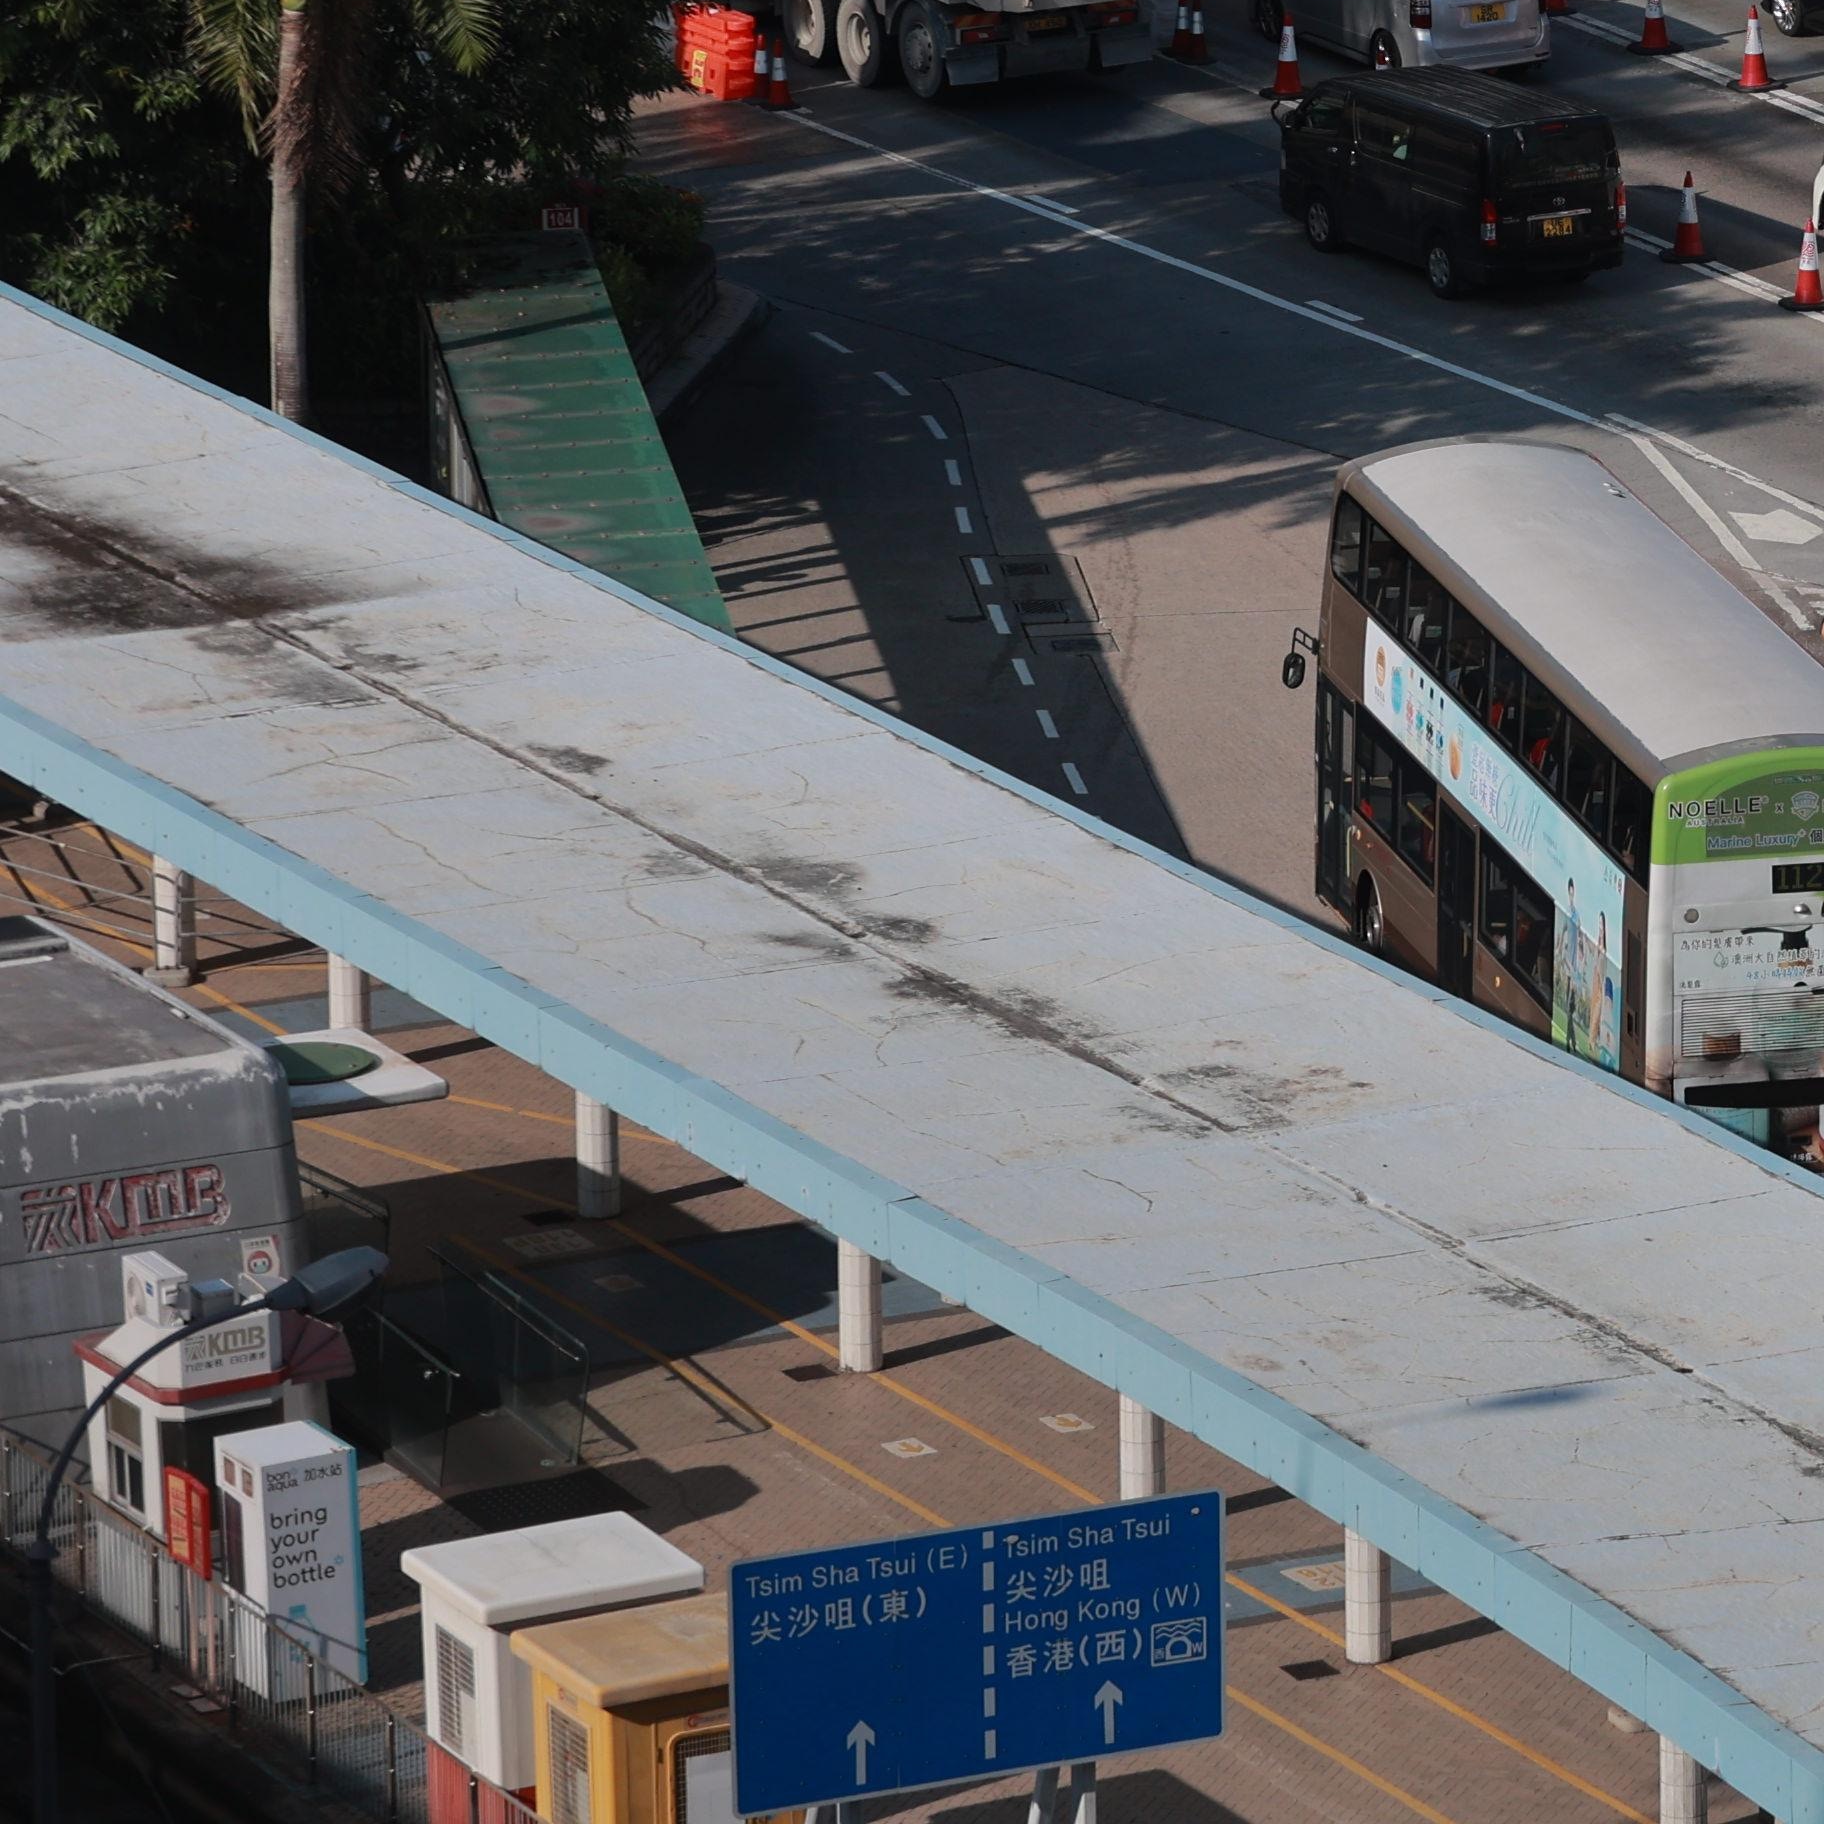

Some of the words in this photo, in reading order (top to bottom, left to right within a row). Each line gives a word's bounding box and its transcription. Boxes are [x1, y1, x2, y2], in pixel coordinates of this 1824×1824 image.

[1669, 795, 1762, 819] NOELLE
[1686, 815, 1745, 827] AUSTRALIA
[1708, 835, 1752, 850] Marine
[1755, 832, 1800, 849] Luxury
[1776, 864, 1824, 892] 112
[266, 1472, 290, 1483] bon
[266, 1480, 298, 1493] aqua
[270, 1506, 328, 1530] bring
[270, 1527, 320, 1554] your
[1003, 1533, 1060, 1560] Tsim
[1068, 1524, 1114, 1552] Sha
[1121, 1514, 1171, 1544] Tsui
[272, 1549, 317, 1570] own
[746, 1575, 802, 1599] Tsim
[812, 1562, 860, 1589] Sha
[866, 1552, 917, 1579] Tsui
[926, 1542, 968, 1572] (E)
[273, 1563, 336, 1590] bottle
[1005, 1559, 1112, 1605] 尖沙咀
[749, 1586, 928, 1646] 尖沙咀(東)
[1004, 1606, 1069, 1635] Hong
[1077, 1594, 1141, 1625] Kong
[1152, 1581, 1201, 1615] (W)
[1006, 1627, 1144, 1680] 香港(西)
